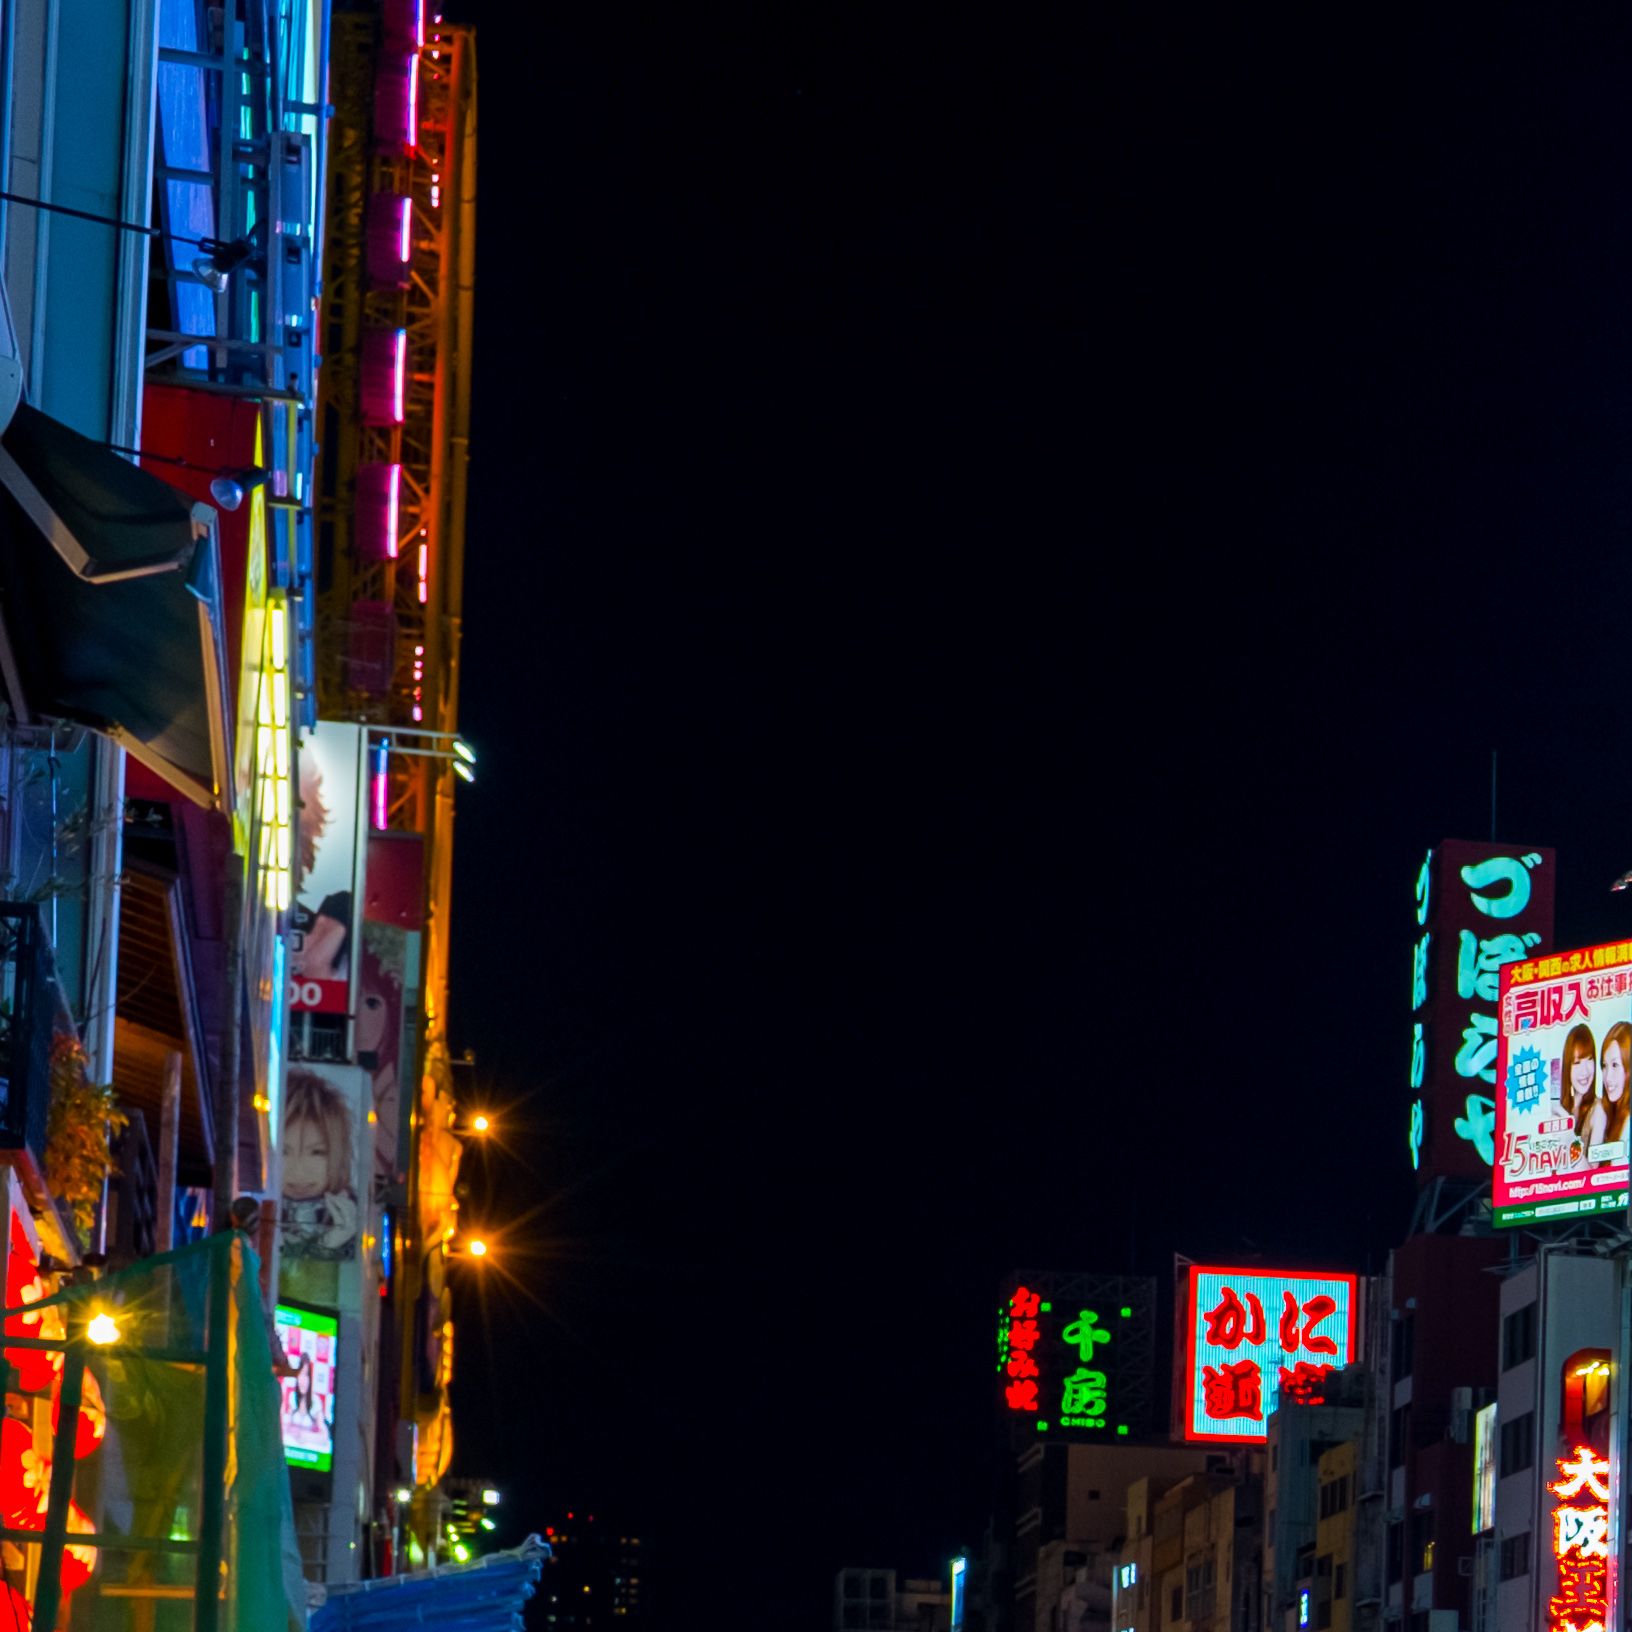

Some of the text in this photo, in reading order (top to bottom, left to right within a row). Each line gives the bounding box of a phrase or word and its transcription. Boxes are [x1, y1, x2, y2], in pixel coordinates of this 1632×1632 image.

[1514, 980, 1590, 1033] 高収入
[1204, 1286, 1338, 1355] かに
[1062, 1310, 1111, 1416] 千房
